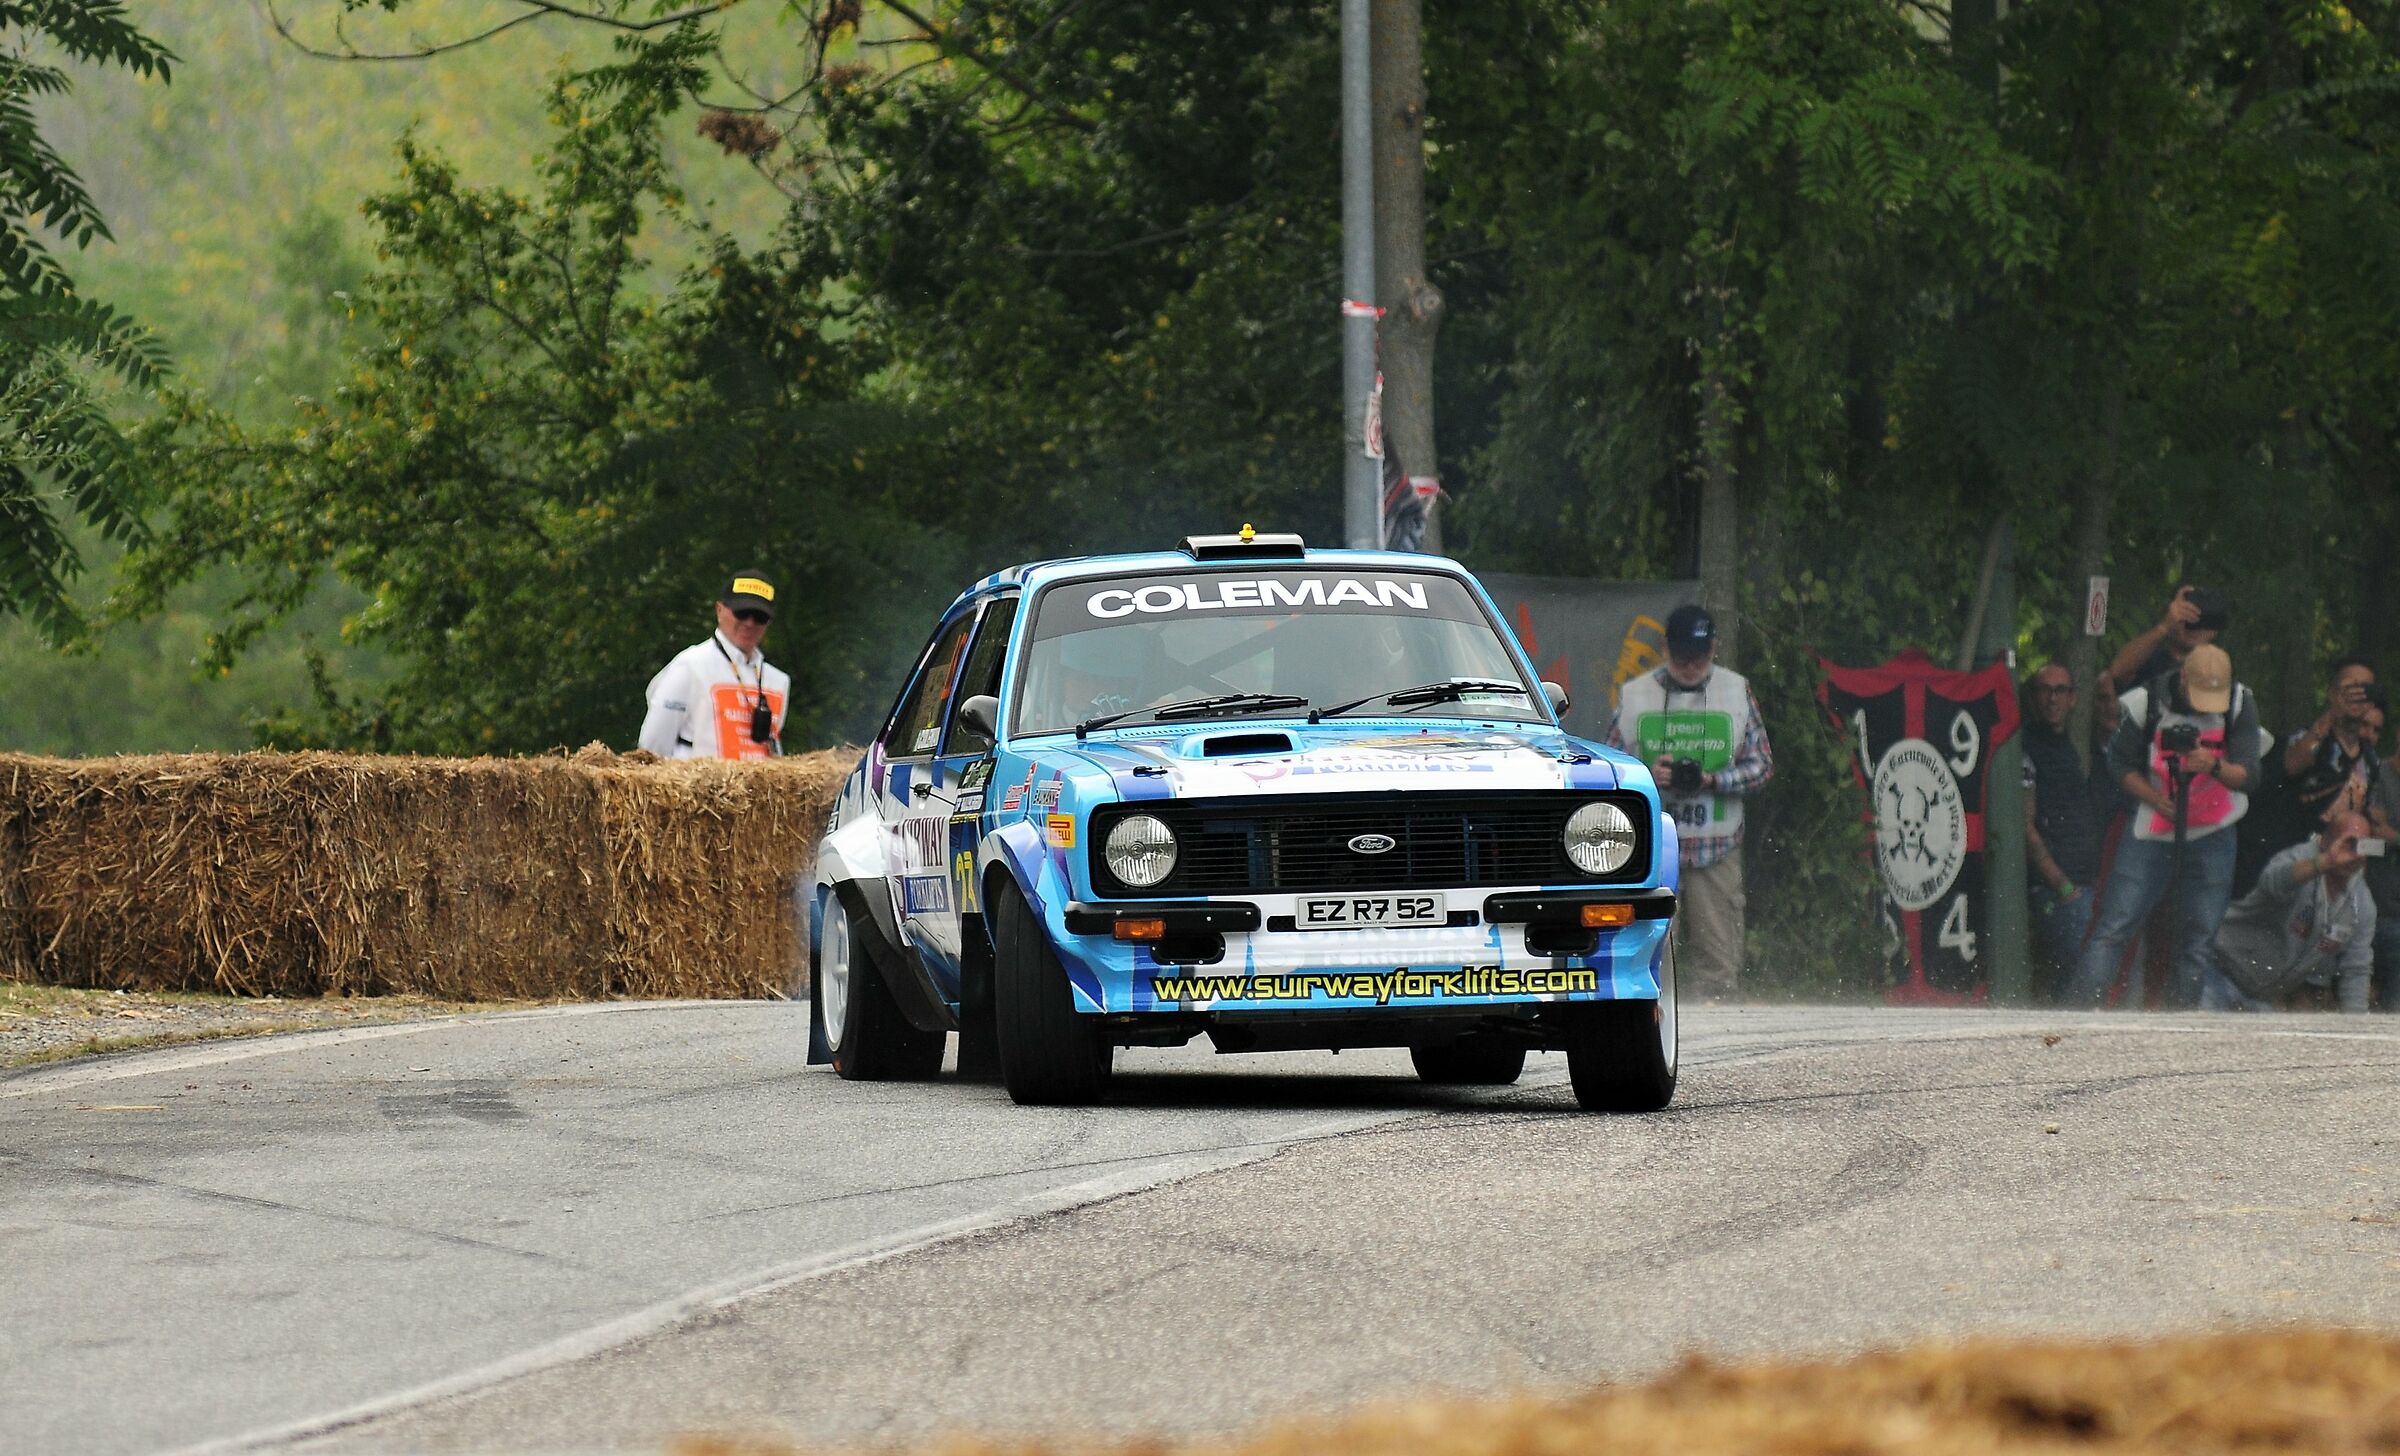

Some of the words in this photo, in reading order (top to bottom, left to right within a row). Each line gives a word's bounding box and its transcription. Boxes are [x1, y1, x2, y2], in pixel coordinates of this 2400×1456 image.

[1086, 579, 1430, 619] COLEMAN
[1951, 708, 1981, 779] 9
[1358, 837, 1385, 850] Ford
[1307, 900, 1347, 922] EZ
[1352, 899, 1390, 921] R7
[1396, 897, 1436, 920] 52
[1938, 892, 1978, 963] 4
[1153, 967, 1597, 1004] www.suirwayforklifts.com
